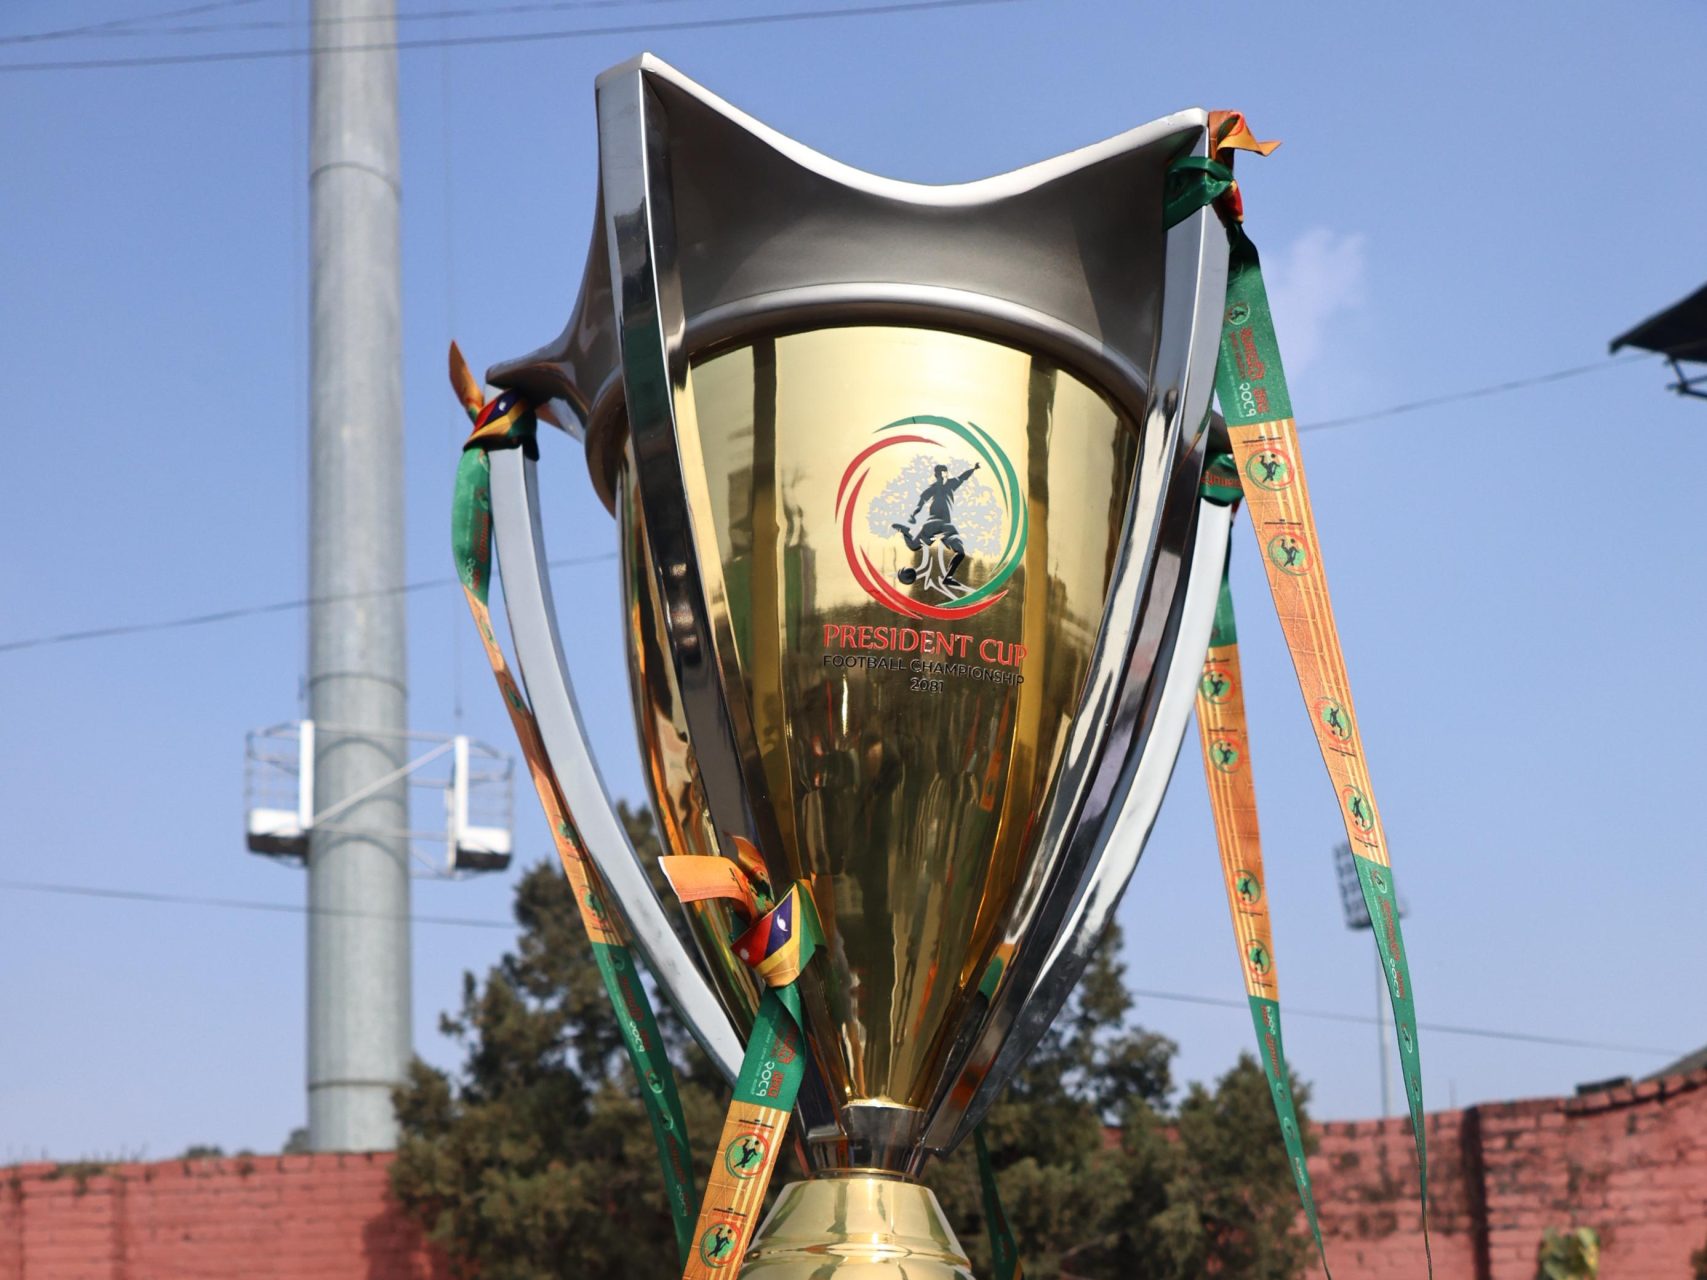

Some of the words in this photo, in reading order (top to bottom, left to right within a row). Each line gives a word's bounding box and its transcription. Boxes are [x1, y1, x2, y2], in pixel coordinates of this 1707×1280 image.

[1237, 382, 1257, 418] २०८१
[822, 624, 973, 658] PRESIDENT
[979, 638, 1028, 668] CUP
[822, 655, 906, 671] FOOTBALL
[909, 658, 1025, 687] CHAMPIONSHIP
[911, 677, 945, 693] 2081
[756, 1060, 776, 1098] २०८१
